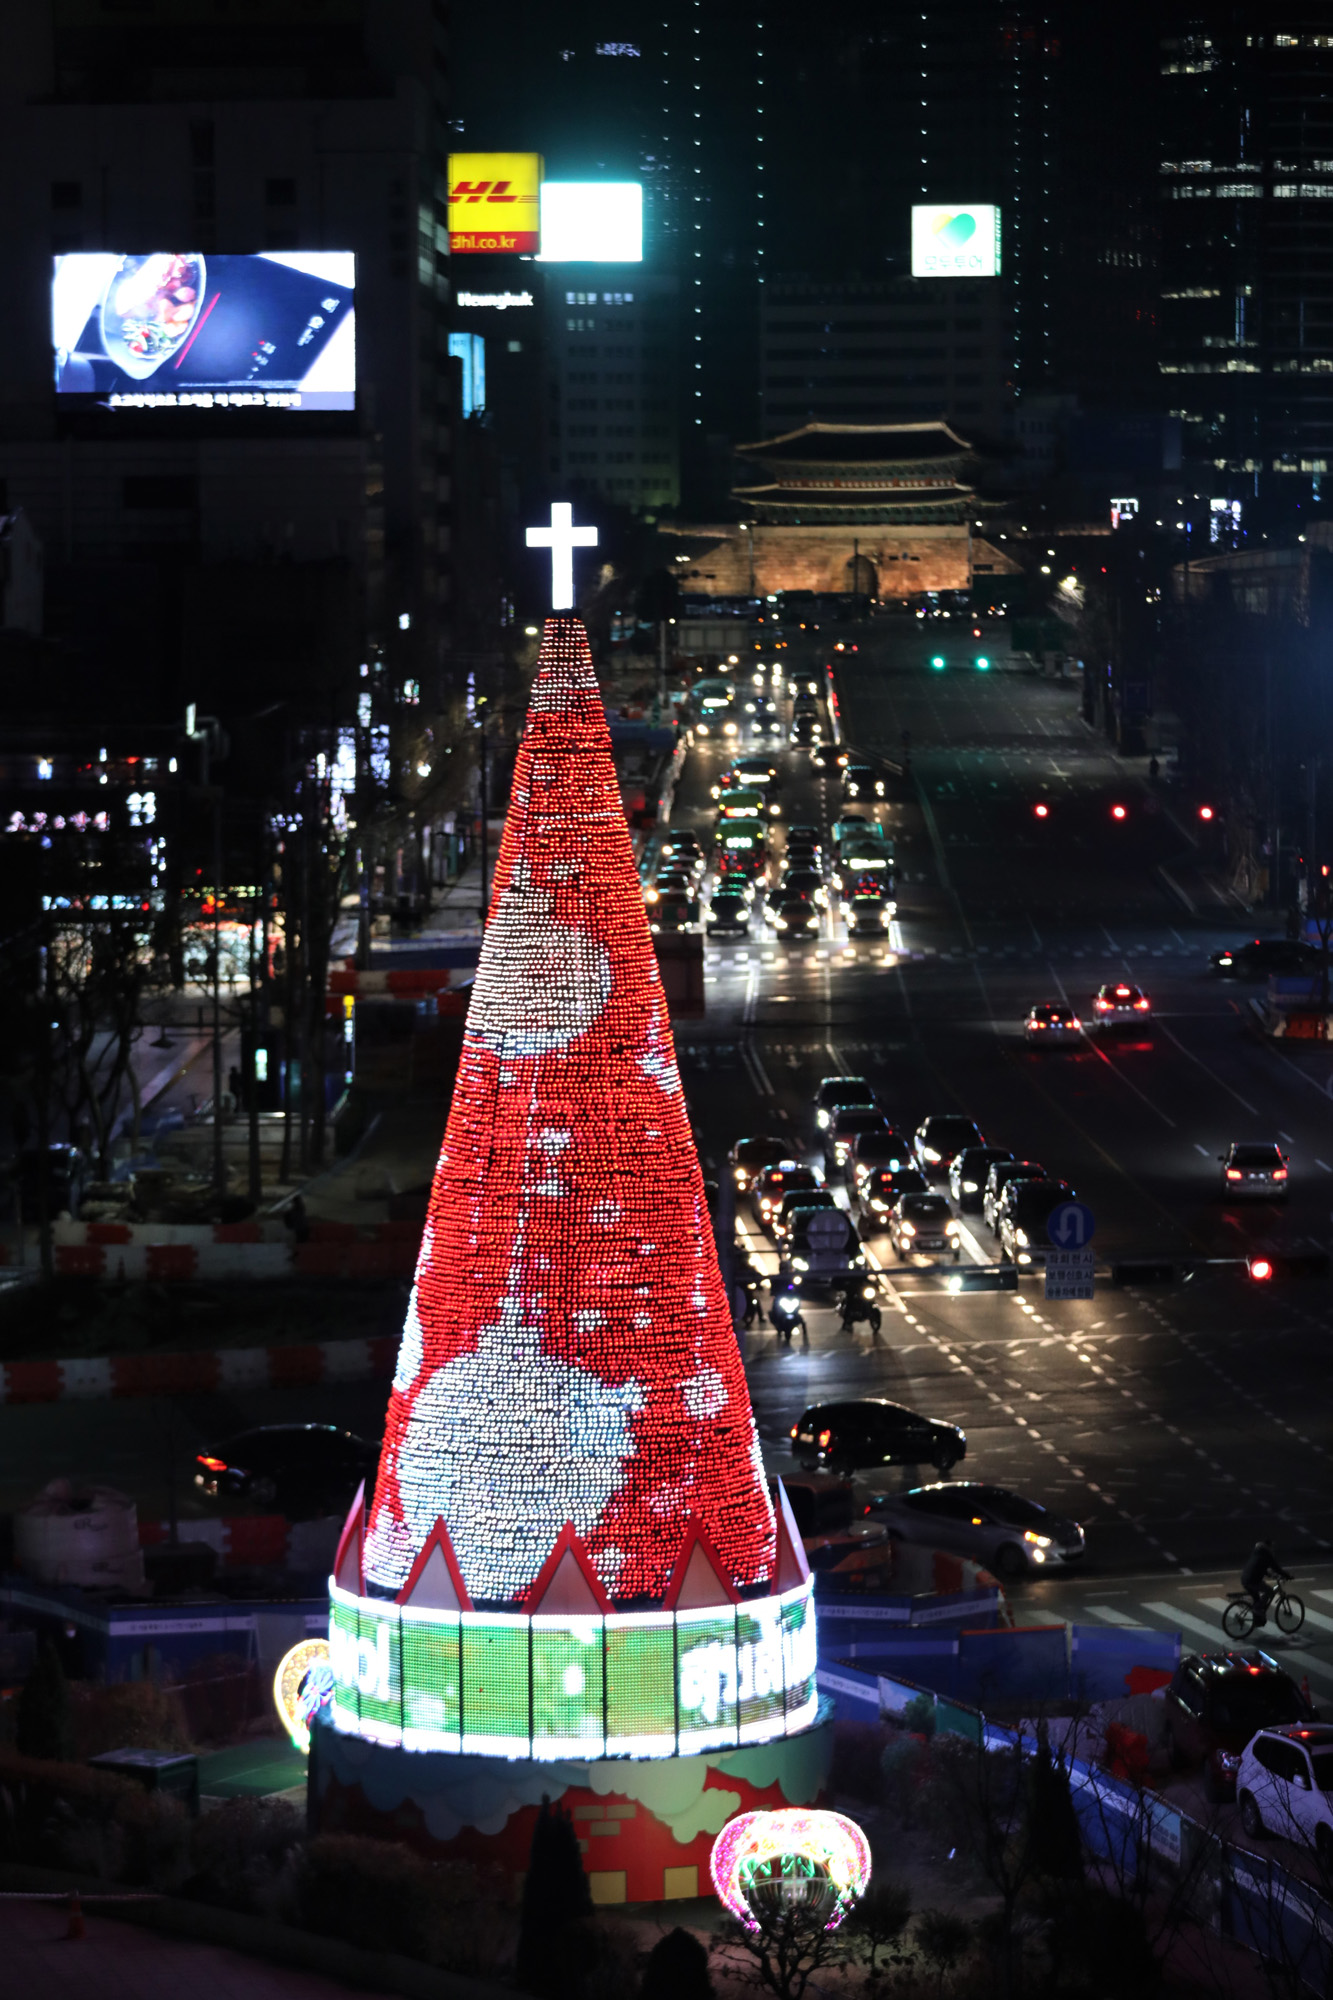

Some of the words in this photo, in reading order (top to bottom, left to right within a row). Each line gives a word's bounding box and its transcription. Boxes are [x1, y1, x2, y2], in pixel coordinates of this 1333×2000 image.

[448, 181, 519, 203] HL
[451, 235, 517, 249] dhl.co.kr
[924, 255, 983, 271] 모두투어
